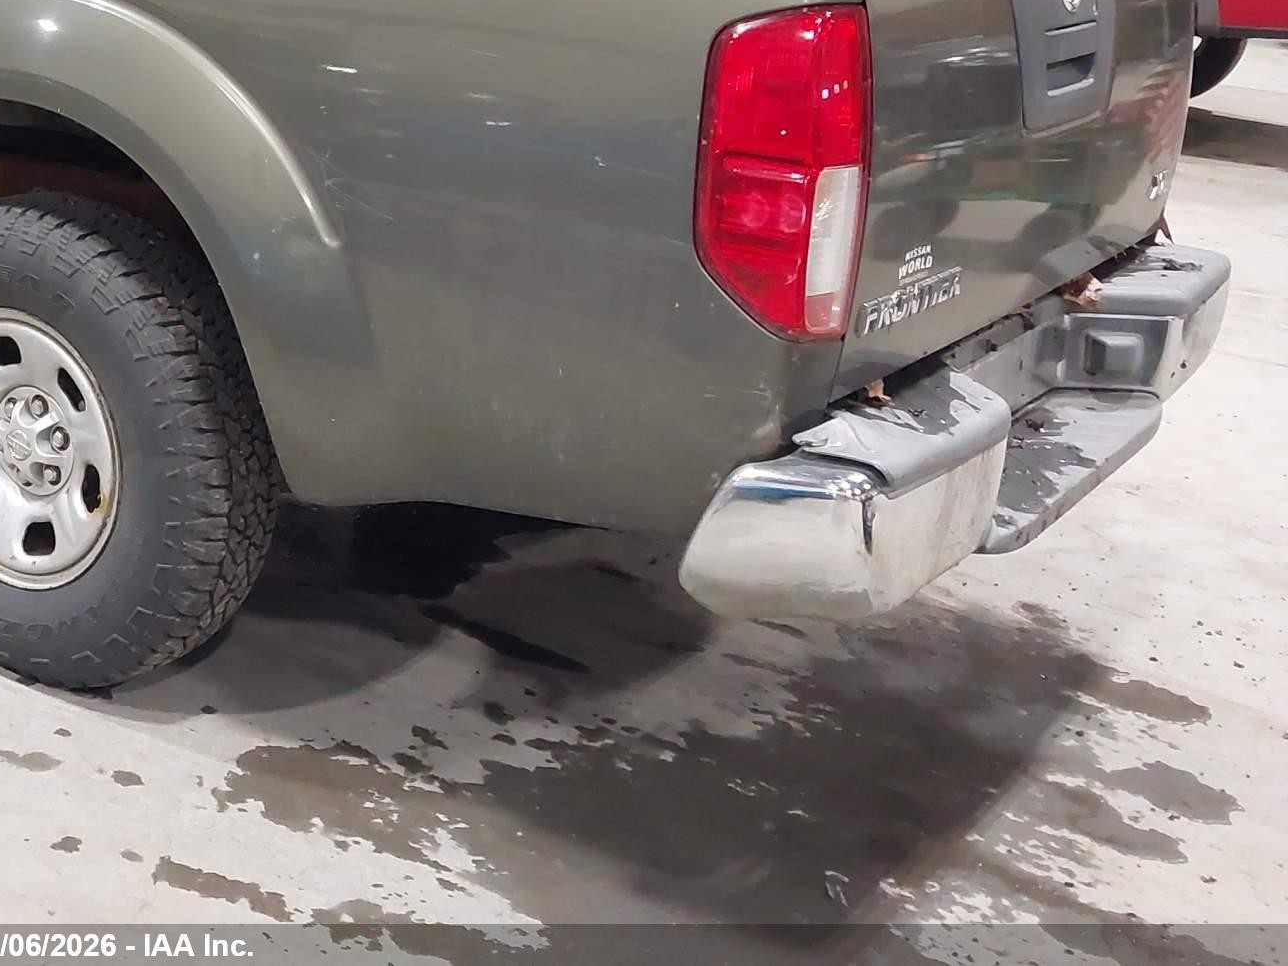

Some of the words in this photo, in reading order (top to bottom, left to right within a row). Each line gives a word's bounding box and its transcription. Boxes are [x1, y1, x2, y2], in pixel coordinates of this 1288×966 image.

[905, 245, 932, 261] NISSAN
[898, 255, 933, 280] WORLD
[858, 266, 962, 336] FRONTIER
